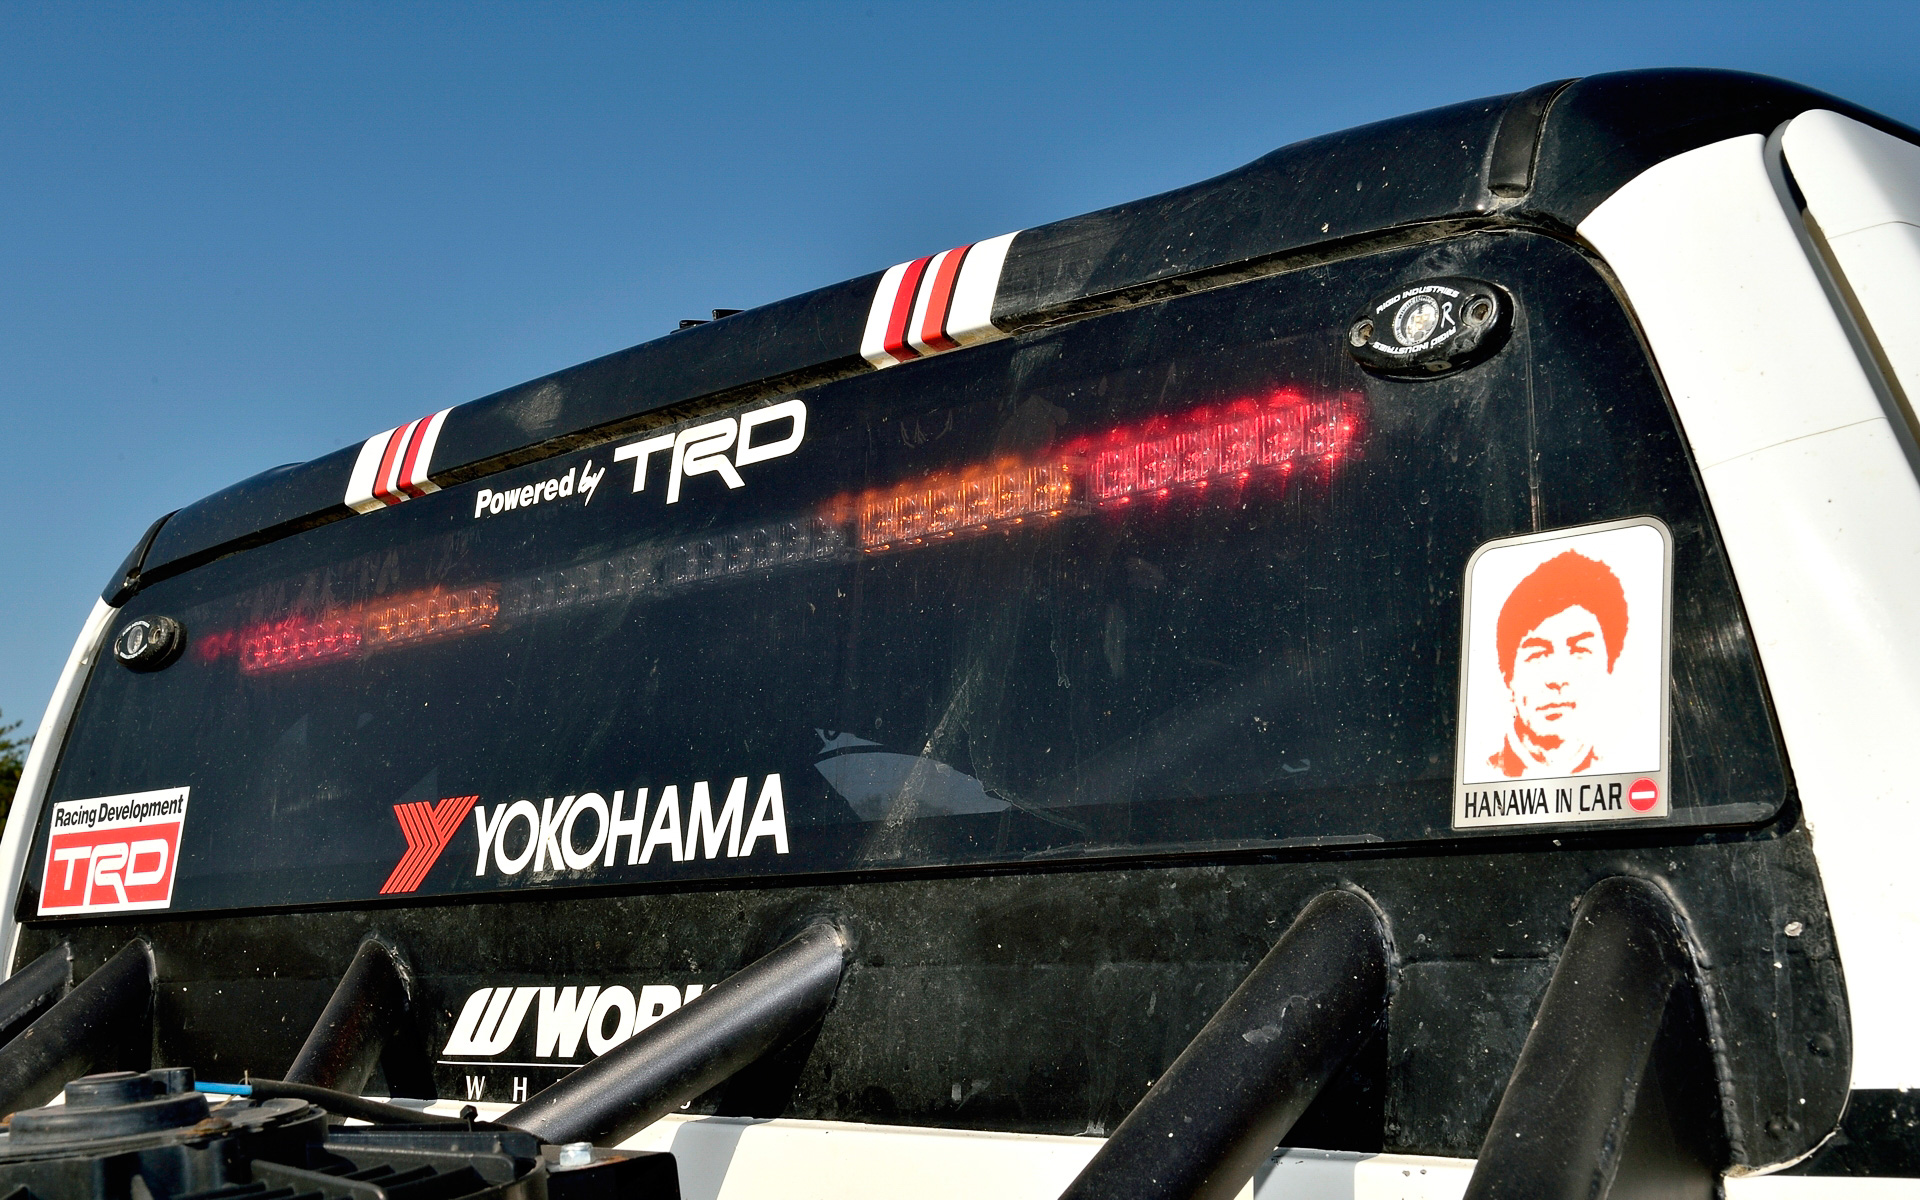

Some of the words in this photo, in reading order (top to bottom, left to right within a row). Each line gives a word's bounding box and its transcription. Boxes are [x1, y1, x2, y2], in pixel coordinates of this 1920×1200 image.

[1375, 294, 1401, 314] RIGID
[1402, 285, 1460, 298] INDUSTRIES
[474, 465, 574, 518] Powered
[577, 459, 606, 507] by
[613, 399, 807, 505] TRD
[54, 805, 97, 828] Racing
[98, 794, 184, 822] Development
[474, 773, 790, 877] YOKOHAMA
[1464, 787, 1549, 818] HANAWA
[1555, 788, 1573, 813] IN
[1579, 782, 1623, 812] CAR
[53, 838, 169, 906] TRD
[536, 984, 718, 1058] WOR
